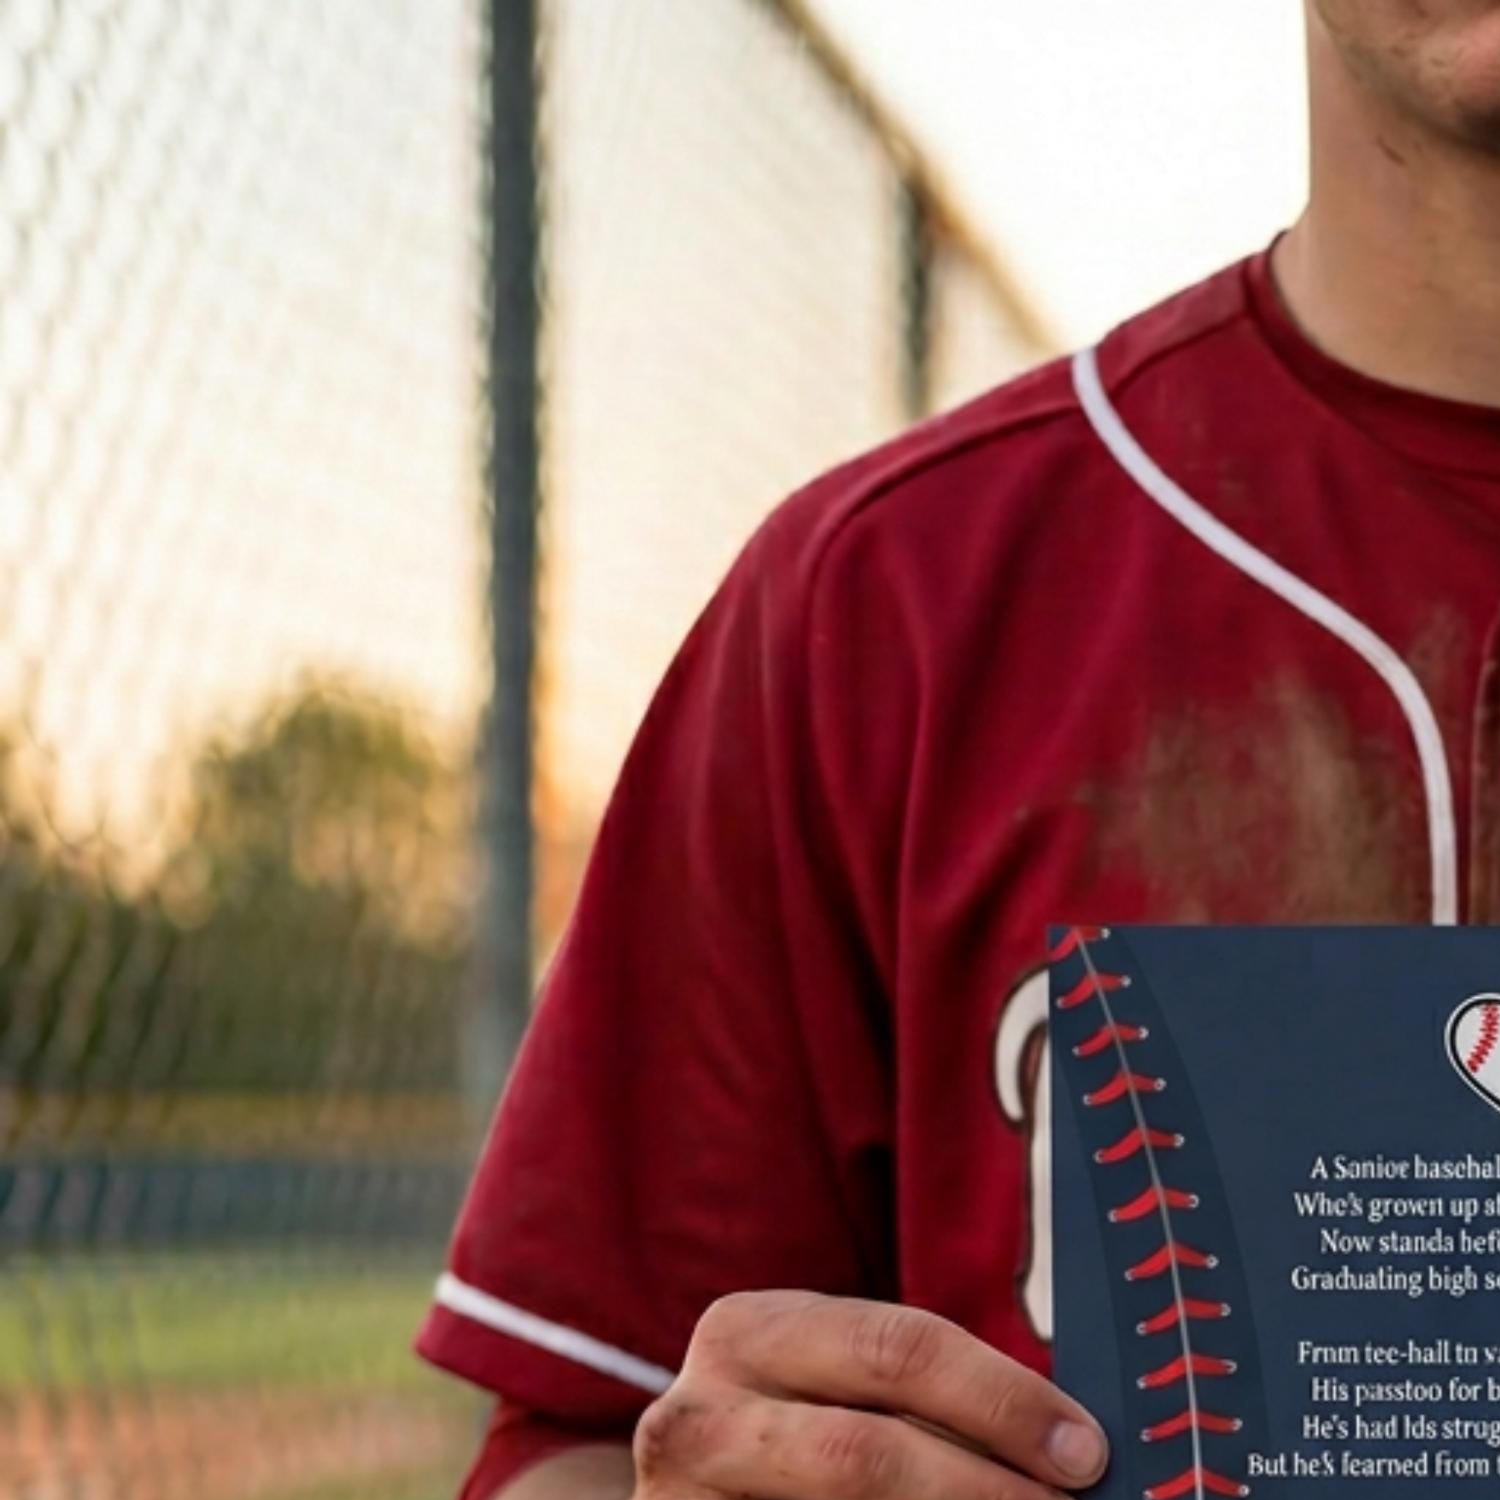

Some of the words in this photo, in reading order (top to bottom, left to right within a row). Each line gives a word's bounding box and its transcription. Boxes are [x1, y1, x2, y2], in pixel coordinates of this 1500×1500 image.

[1309, 1155, 1329, 1180] A
[1449, 1197, 1480, 1224] up
[1320, 1227, 1375, 1254] Now
[1311, 1376, 1350, 1402] His
[1302, 1413, 1349, 1440] He's
[1354, 1413, 1399, 1440] had
